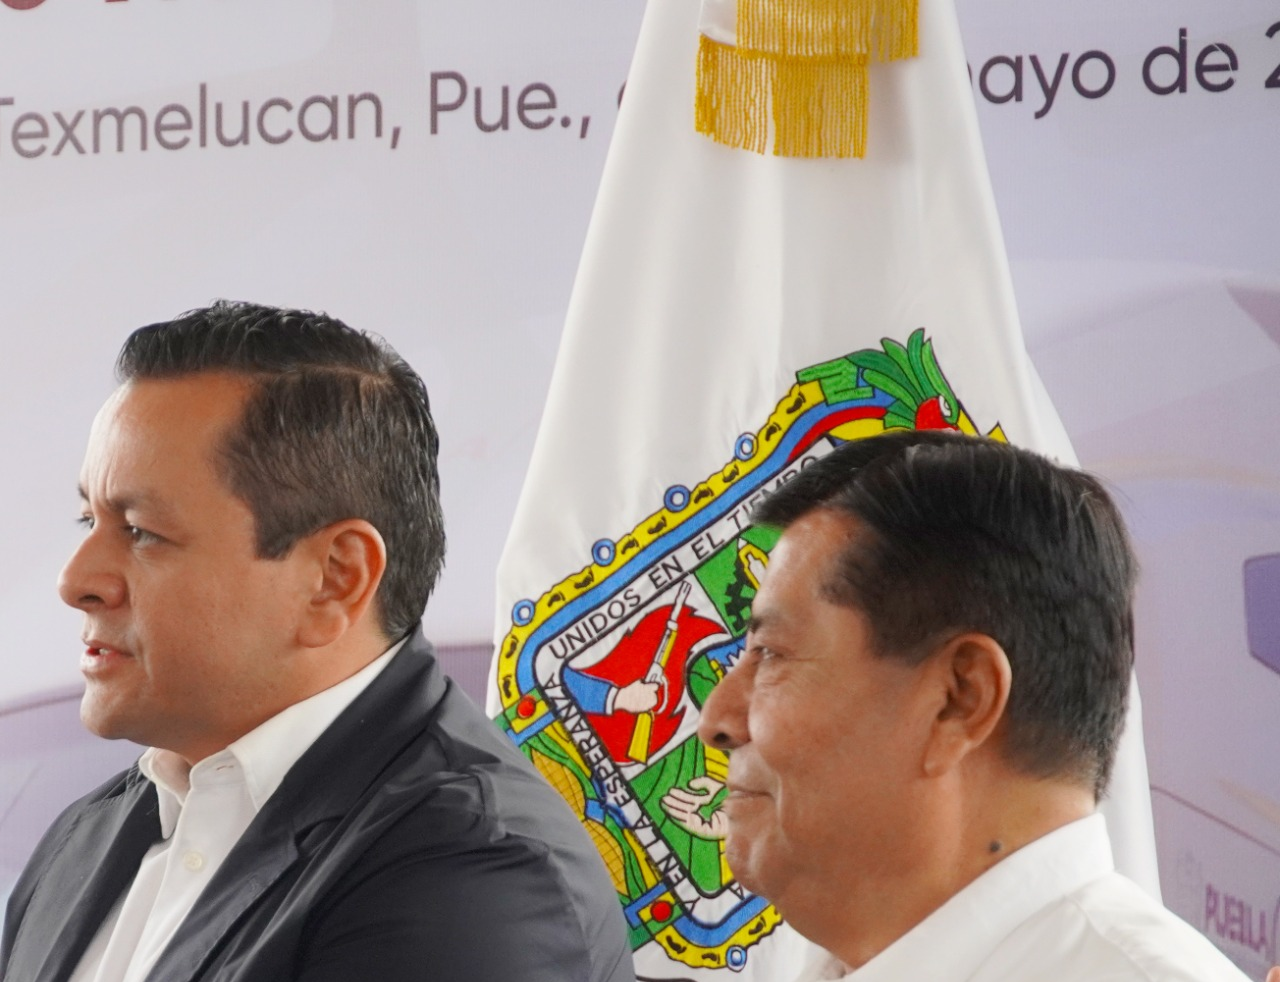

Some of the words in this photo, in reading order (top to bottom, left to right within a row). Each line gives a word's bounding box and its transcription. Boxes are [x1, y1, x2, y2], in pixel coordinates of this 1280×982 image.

[428, 70, 592, 139] Pue.,
[967, 50, 1117, 119] ayo
[1142, 27, 1239, 95] de
[548, 587, 642, 660] UNIDOS
[648, 555, 685, 590] EN
[691, 533, 725, 561] EL
[544, 671, 633, 808] ESPERANZA
